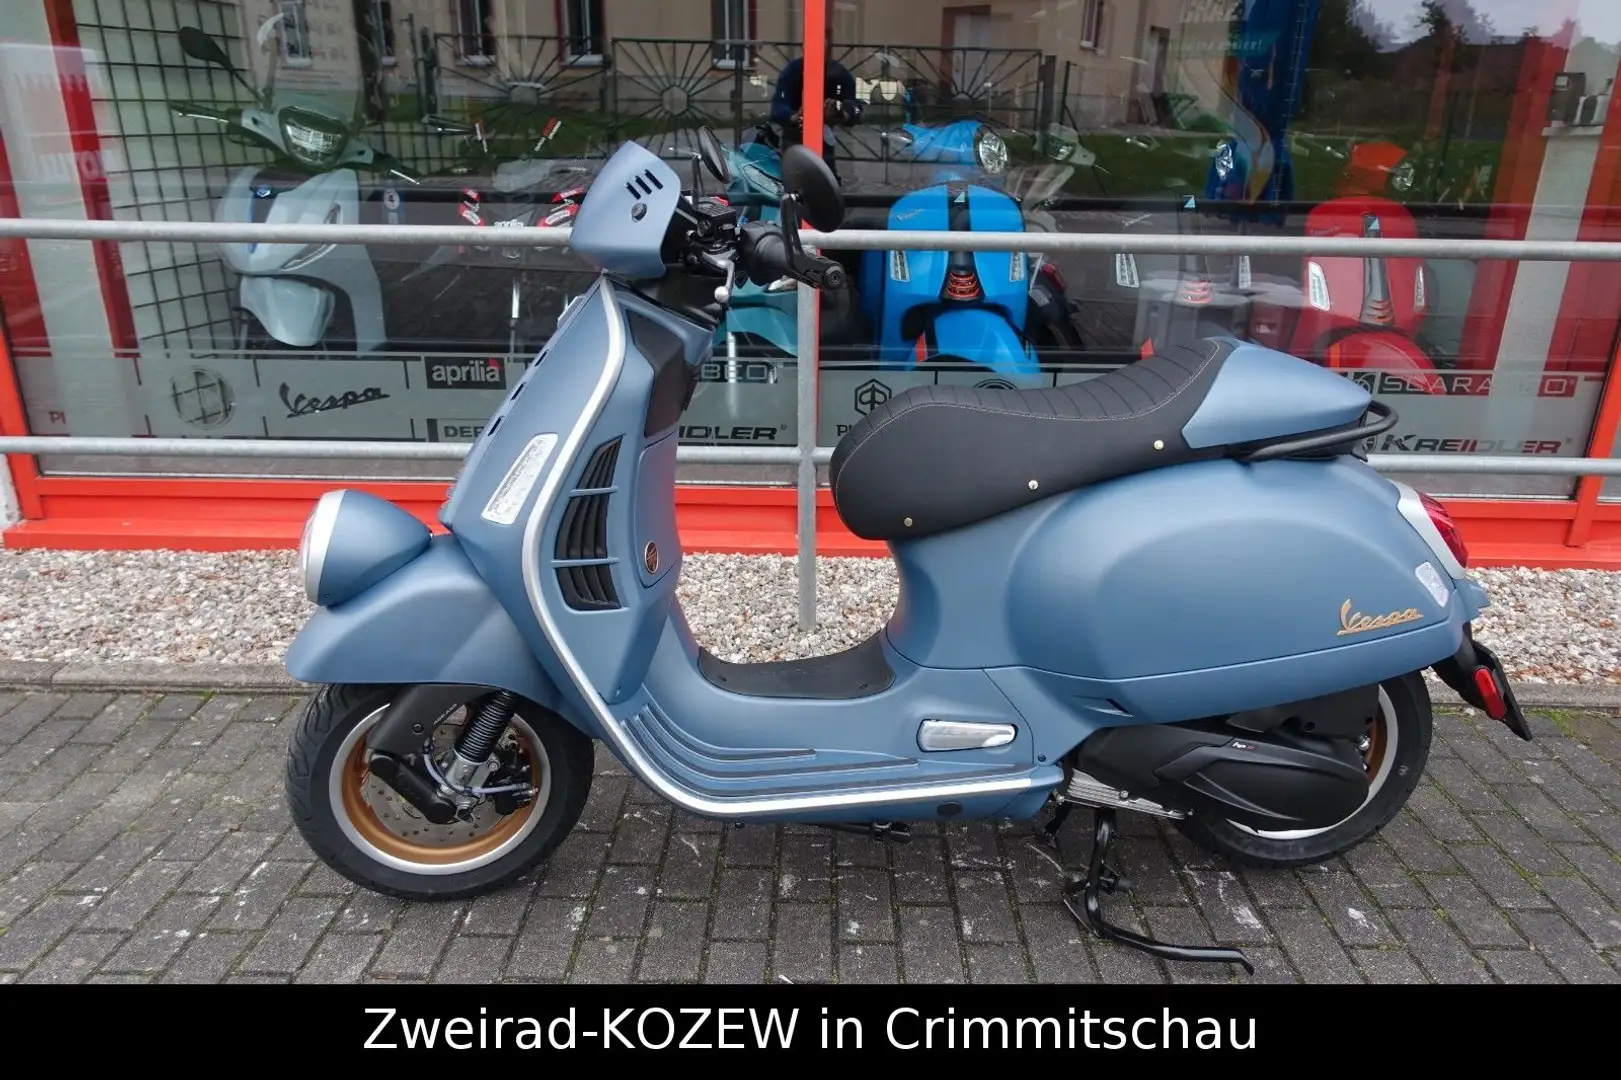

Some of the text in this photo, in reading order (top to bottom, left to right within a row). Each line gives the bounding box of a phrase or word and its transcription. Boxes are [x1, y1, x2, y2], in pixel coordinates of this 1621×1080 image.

[432, 359, 500, 385] aprilia
[279, 382, 391, 419] Vespa
[679, 425, 777, 440] IDLER
[1337, 598, 1423, 635] Vespa
